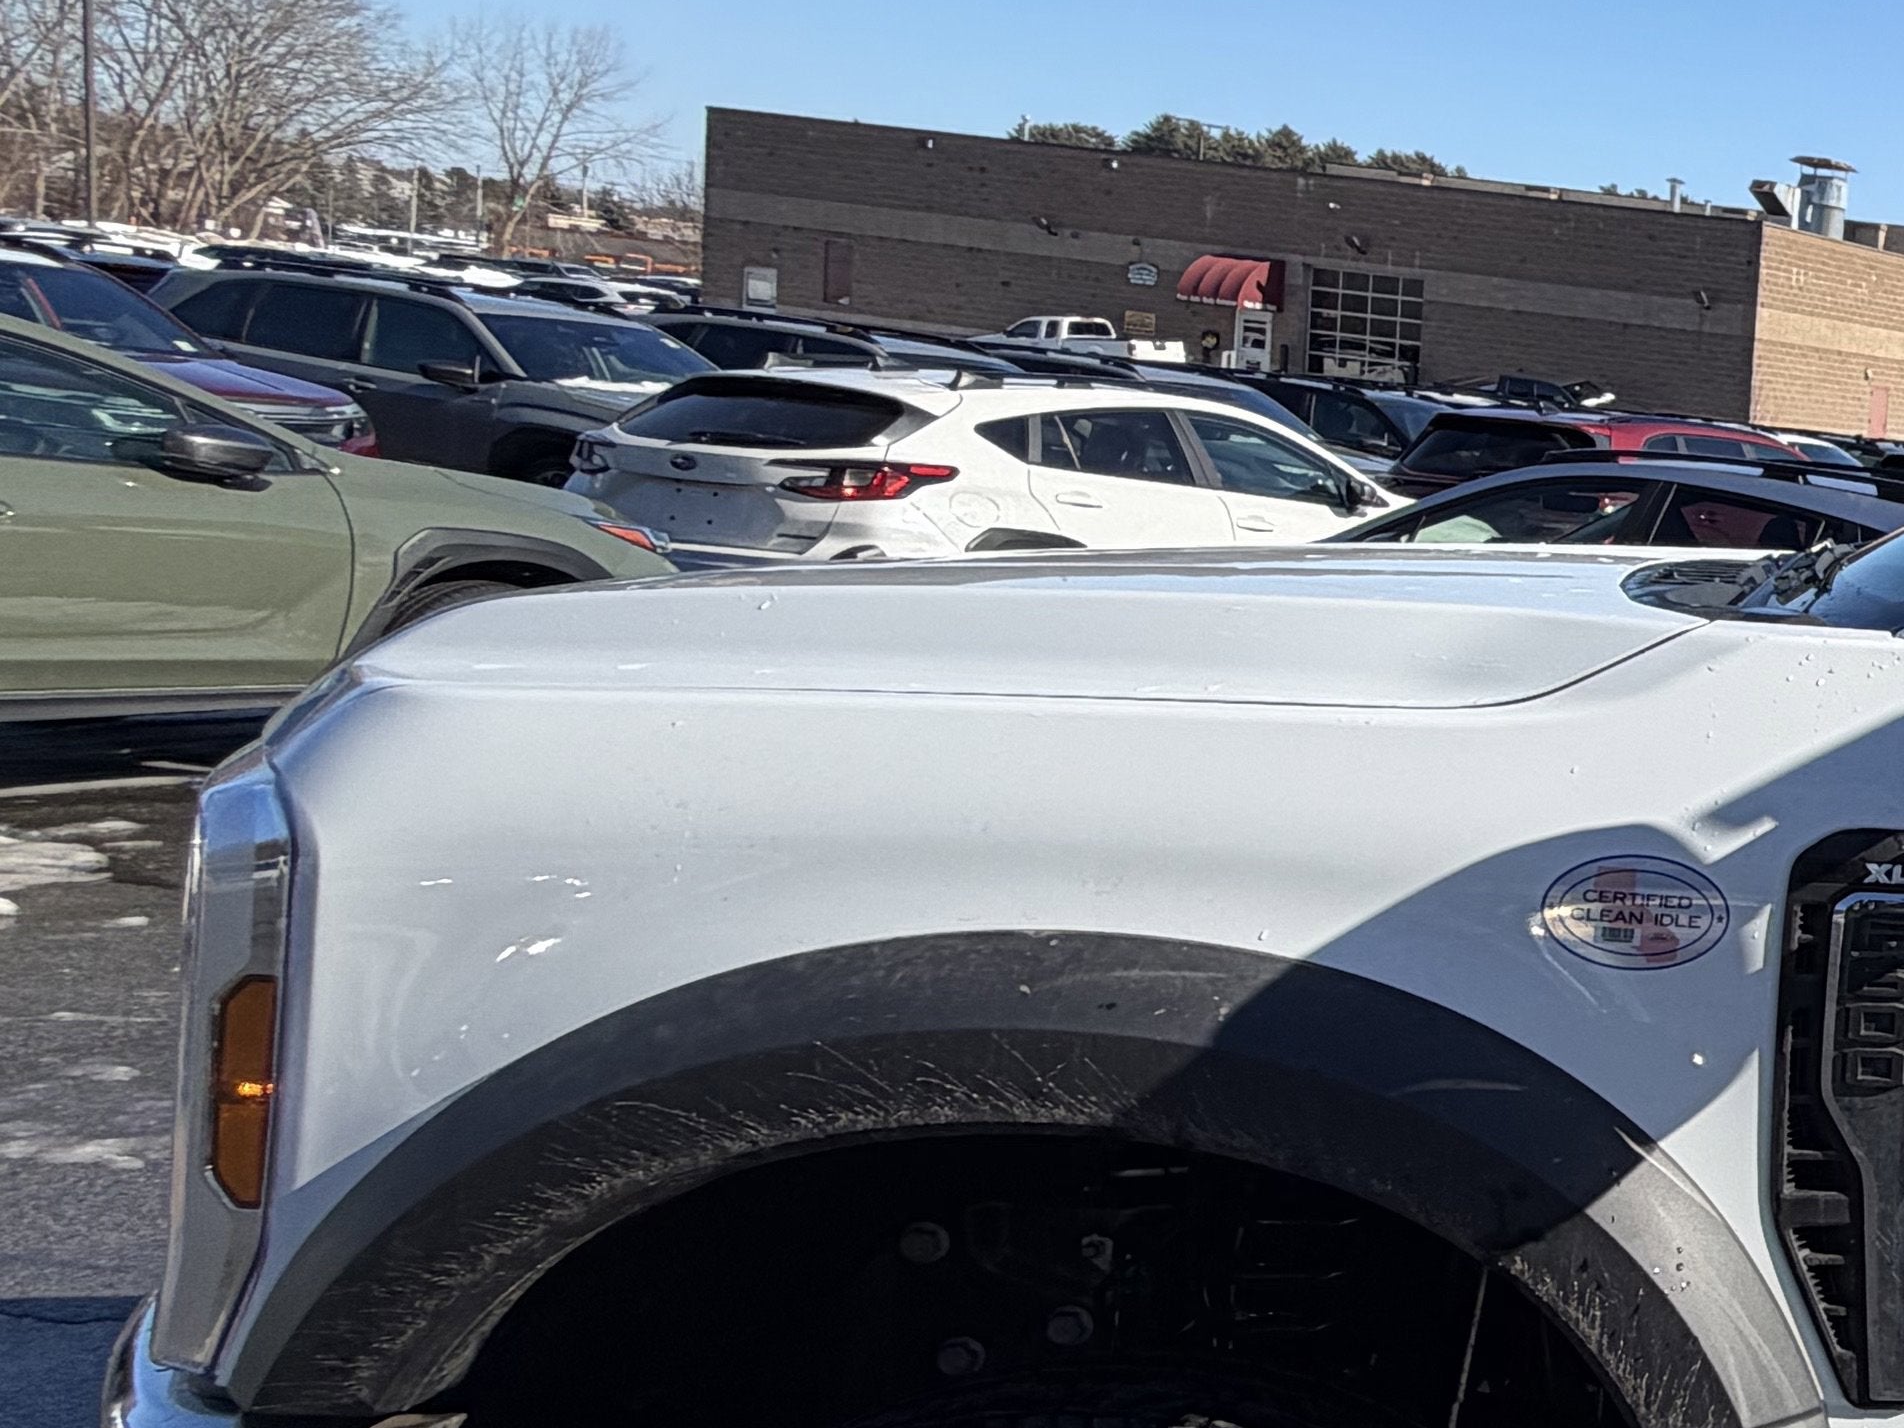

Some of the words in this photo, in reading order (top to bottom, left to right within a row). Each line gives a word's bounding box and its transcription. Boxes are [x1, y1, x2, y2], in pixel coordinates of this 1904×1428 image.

[1583, 889, 1693, 910] CERTIFIED
[1570, 907, 1644, 925] CLEAN
[1654, 913, 1702, 929] IDLE
